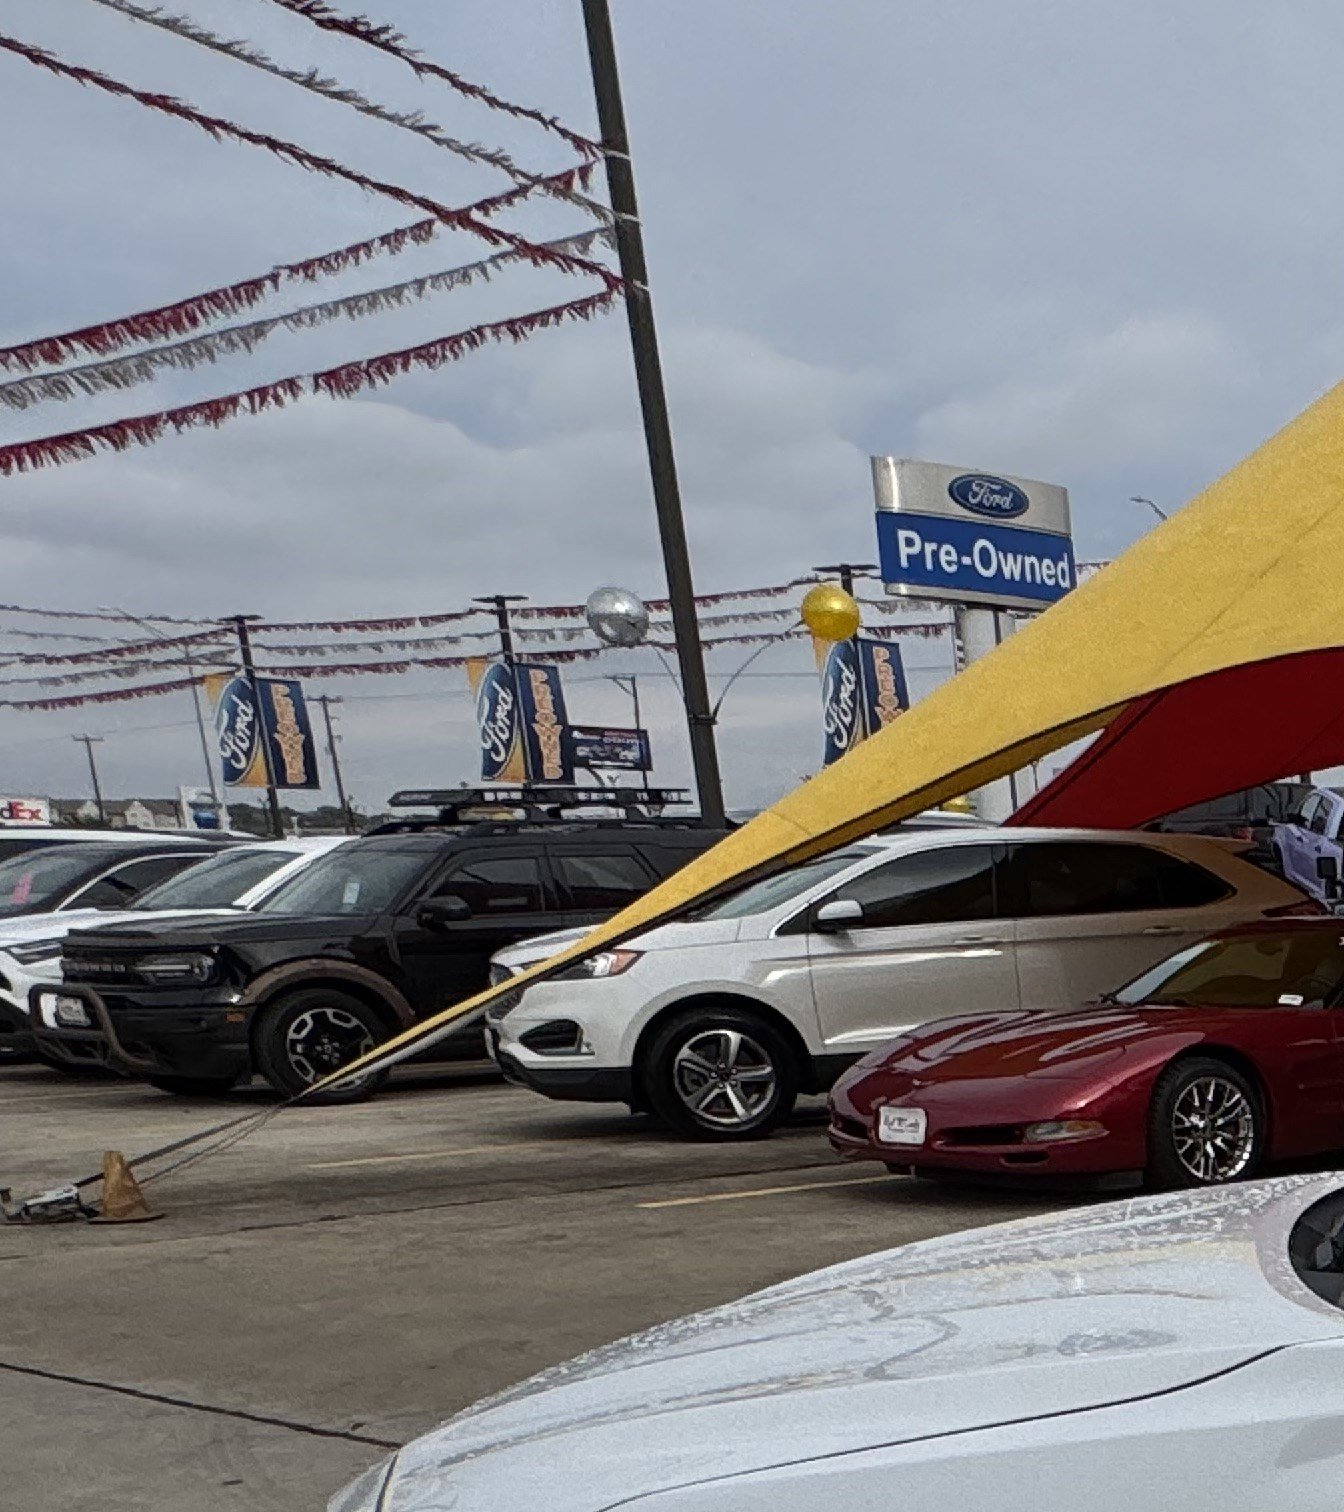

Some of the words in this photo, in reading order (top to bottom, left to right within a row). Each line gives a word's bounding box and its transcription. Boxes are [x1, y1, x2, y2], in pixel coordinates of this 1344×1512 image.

[968, 480, 1014, 510] Ford
[896, 529, 1071, 589] Pre-Owned
[219, 694, 254, 769] Ford
[480, 681, 514, 762] Ford
[824, 656, 857, 749] Ford
